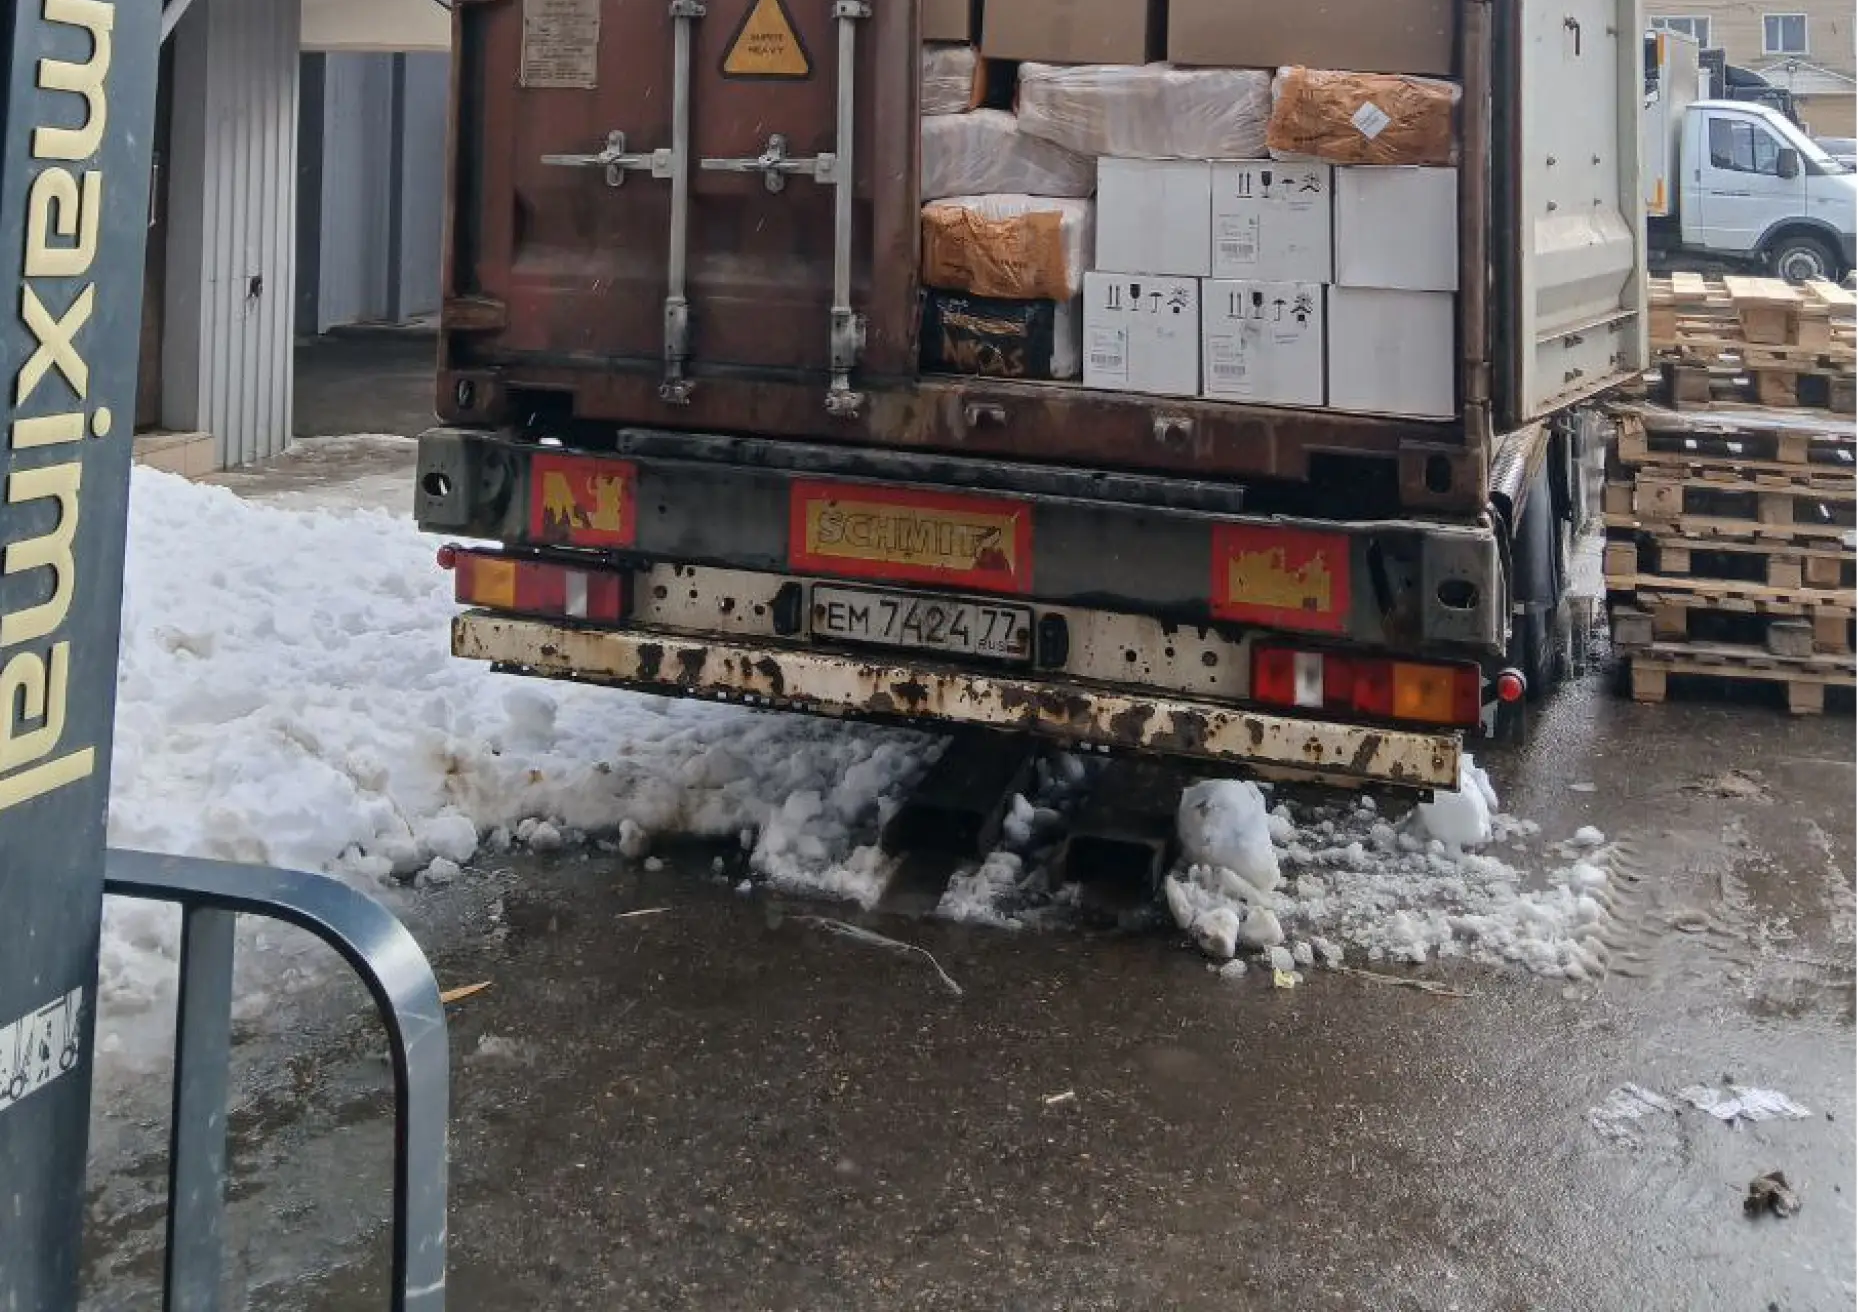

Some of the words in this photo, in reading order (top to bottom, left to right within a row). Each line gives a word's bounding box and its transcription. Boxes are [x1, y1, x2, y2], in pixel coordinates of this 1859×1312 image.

[880, 599, 968, 645] 7424
[981, 609, 1016, 639] 77
[978, 638, 1004, 652] RUS
